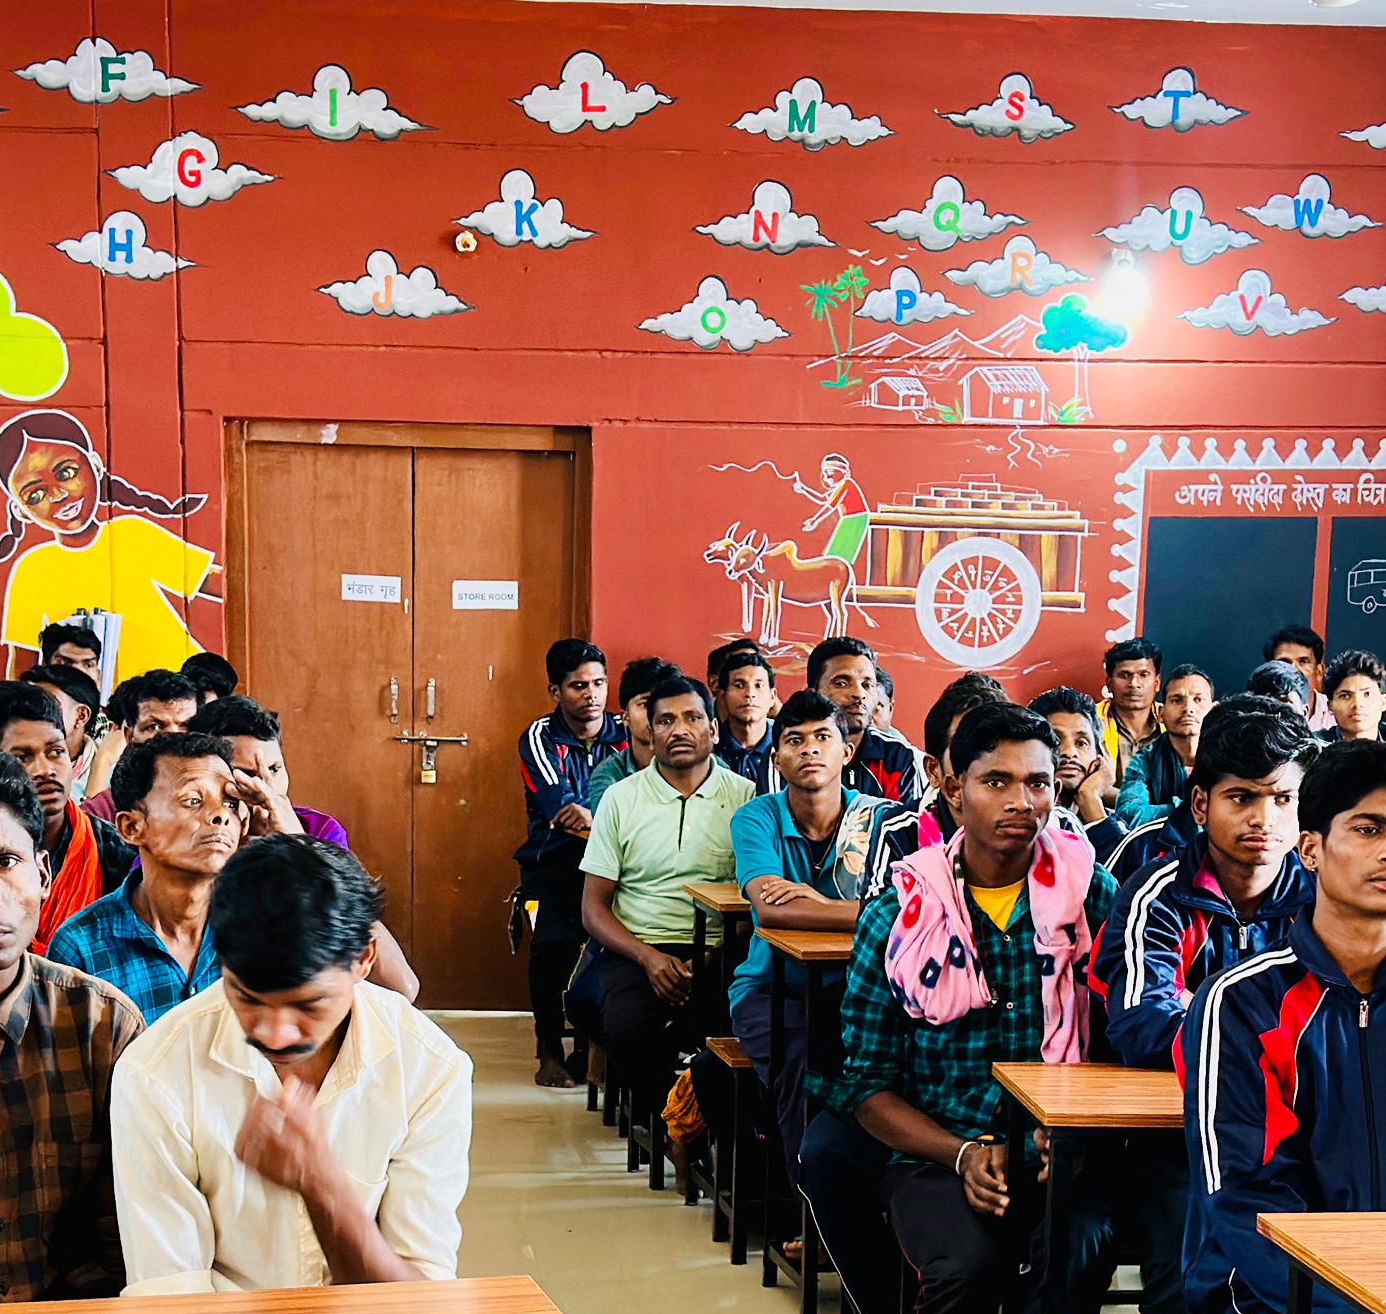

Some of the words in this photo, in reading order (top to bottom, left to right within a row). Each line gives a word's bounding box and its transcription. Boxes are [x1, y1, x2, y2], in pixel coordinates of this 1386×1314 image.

[101, 58, 126, 92] F
[329, 89, 338, 127] I
[581, 81, 607, 113] L
[1005, 91, 1026, 122] S
[1162, 89, 1195, 123] T
[789, 99, 817, 134] M
[177, 148, 206, 189] G
[514, 199, 540, 239] K
[752, 209, 779, 244] N
[933, 202, 961, 235] Q
[1169, 208, 1194, 241] U
[1292, 197, 1325, 229] W
[108, 227, 134, 265] H
[1013, 252, 1032, 283] R
[373, 275, 393, 309] J
[895, 289, 918, 324] P
[1239, 294, 1263, 321] V
[700, 306, 726, 334] O
[1175, 472, 1223, 506] अपने
[1230, 471, 1287, 512] पसंदीदा
[1292, 474, 1329, 512] दोस्त
[1332, 483, 1354, 504] का
[347, 581, 373, 595] भंडार
[380, 584, 396, 599] गृह
[458, 593, 486, 601] STORE
[488, 593, 514, 601] ROOM
